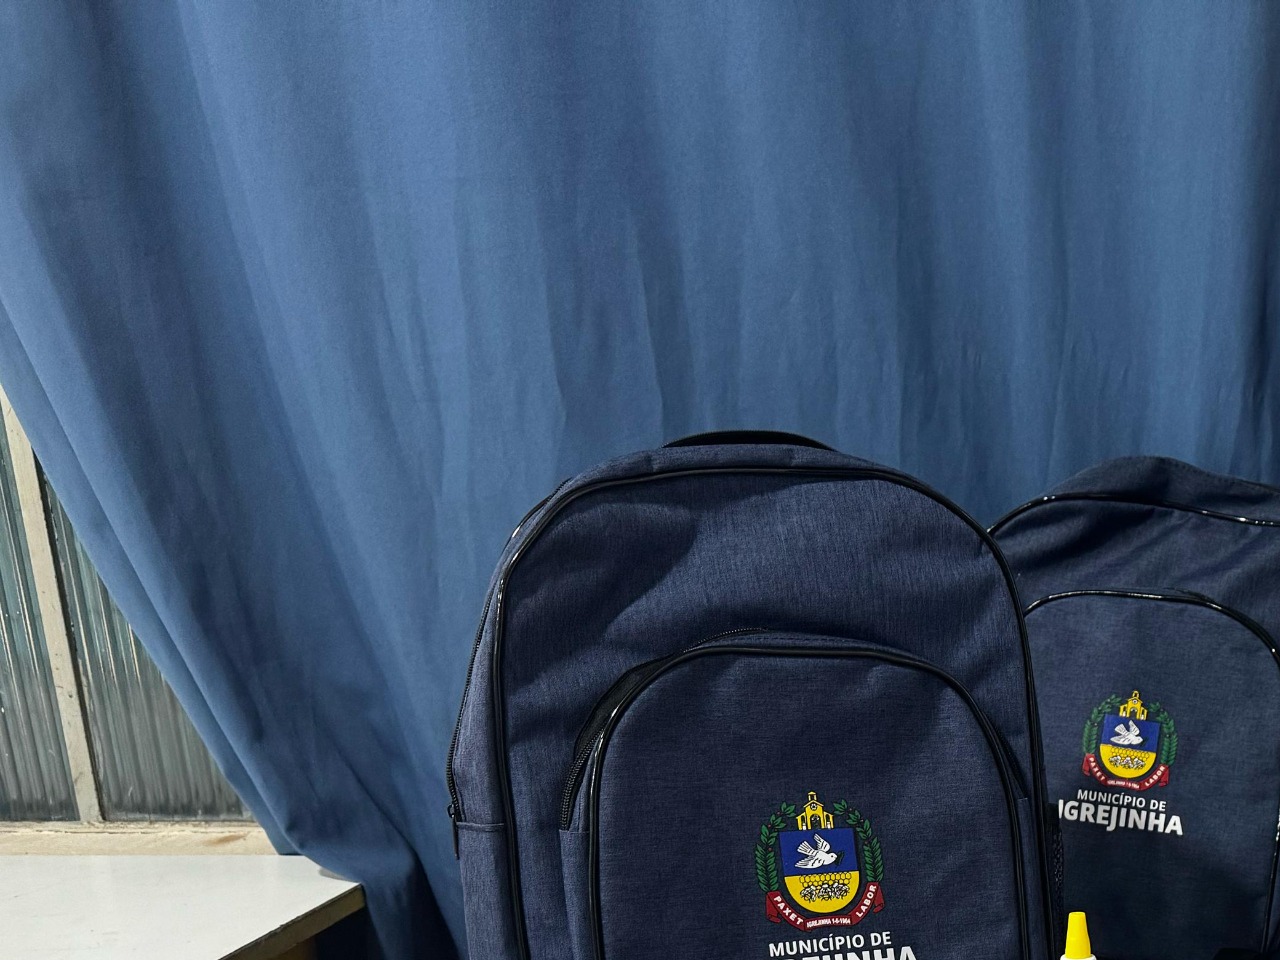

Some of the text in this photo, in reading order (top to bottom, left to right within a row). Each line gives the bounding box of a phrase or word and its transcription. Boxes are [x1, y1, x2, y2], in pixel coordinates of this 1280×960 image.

[1076, 788, 1167, 812] MUNICÍPIO DE
[1058, 799, 1184, 836] IGREJINHA
[856, 884, 877, 917] LABOR
[768, 931, 892, 957] MUNICÍPIO DE
